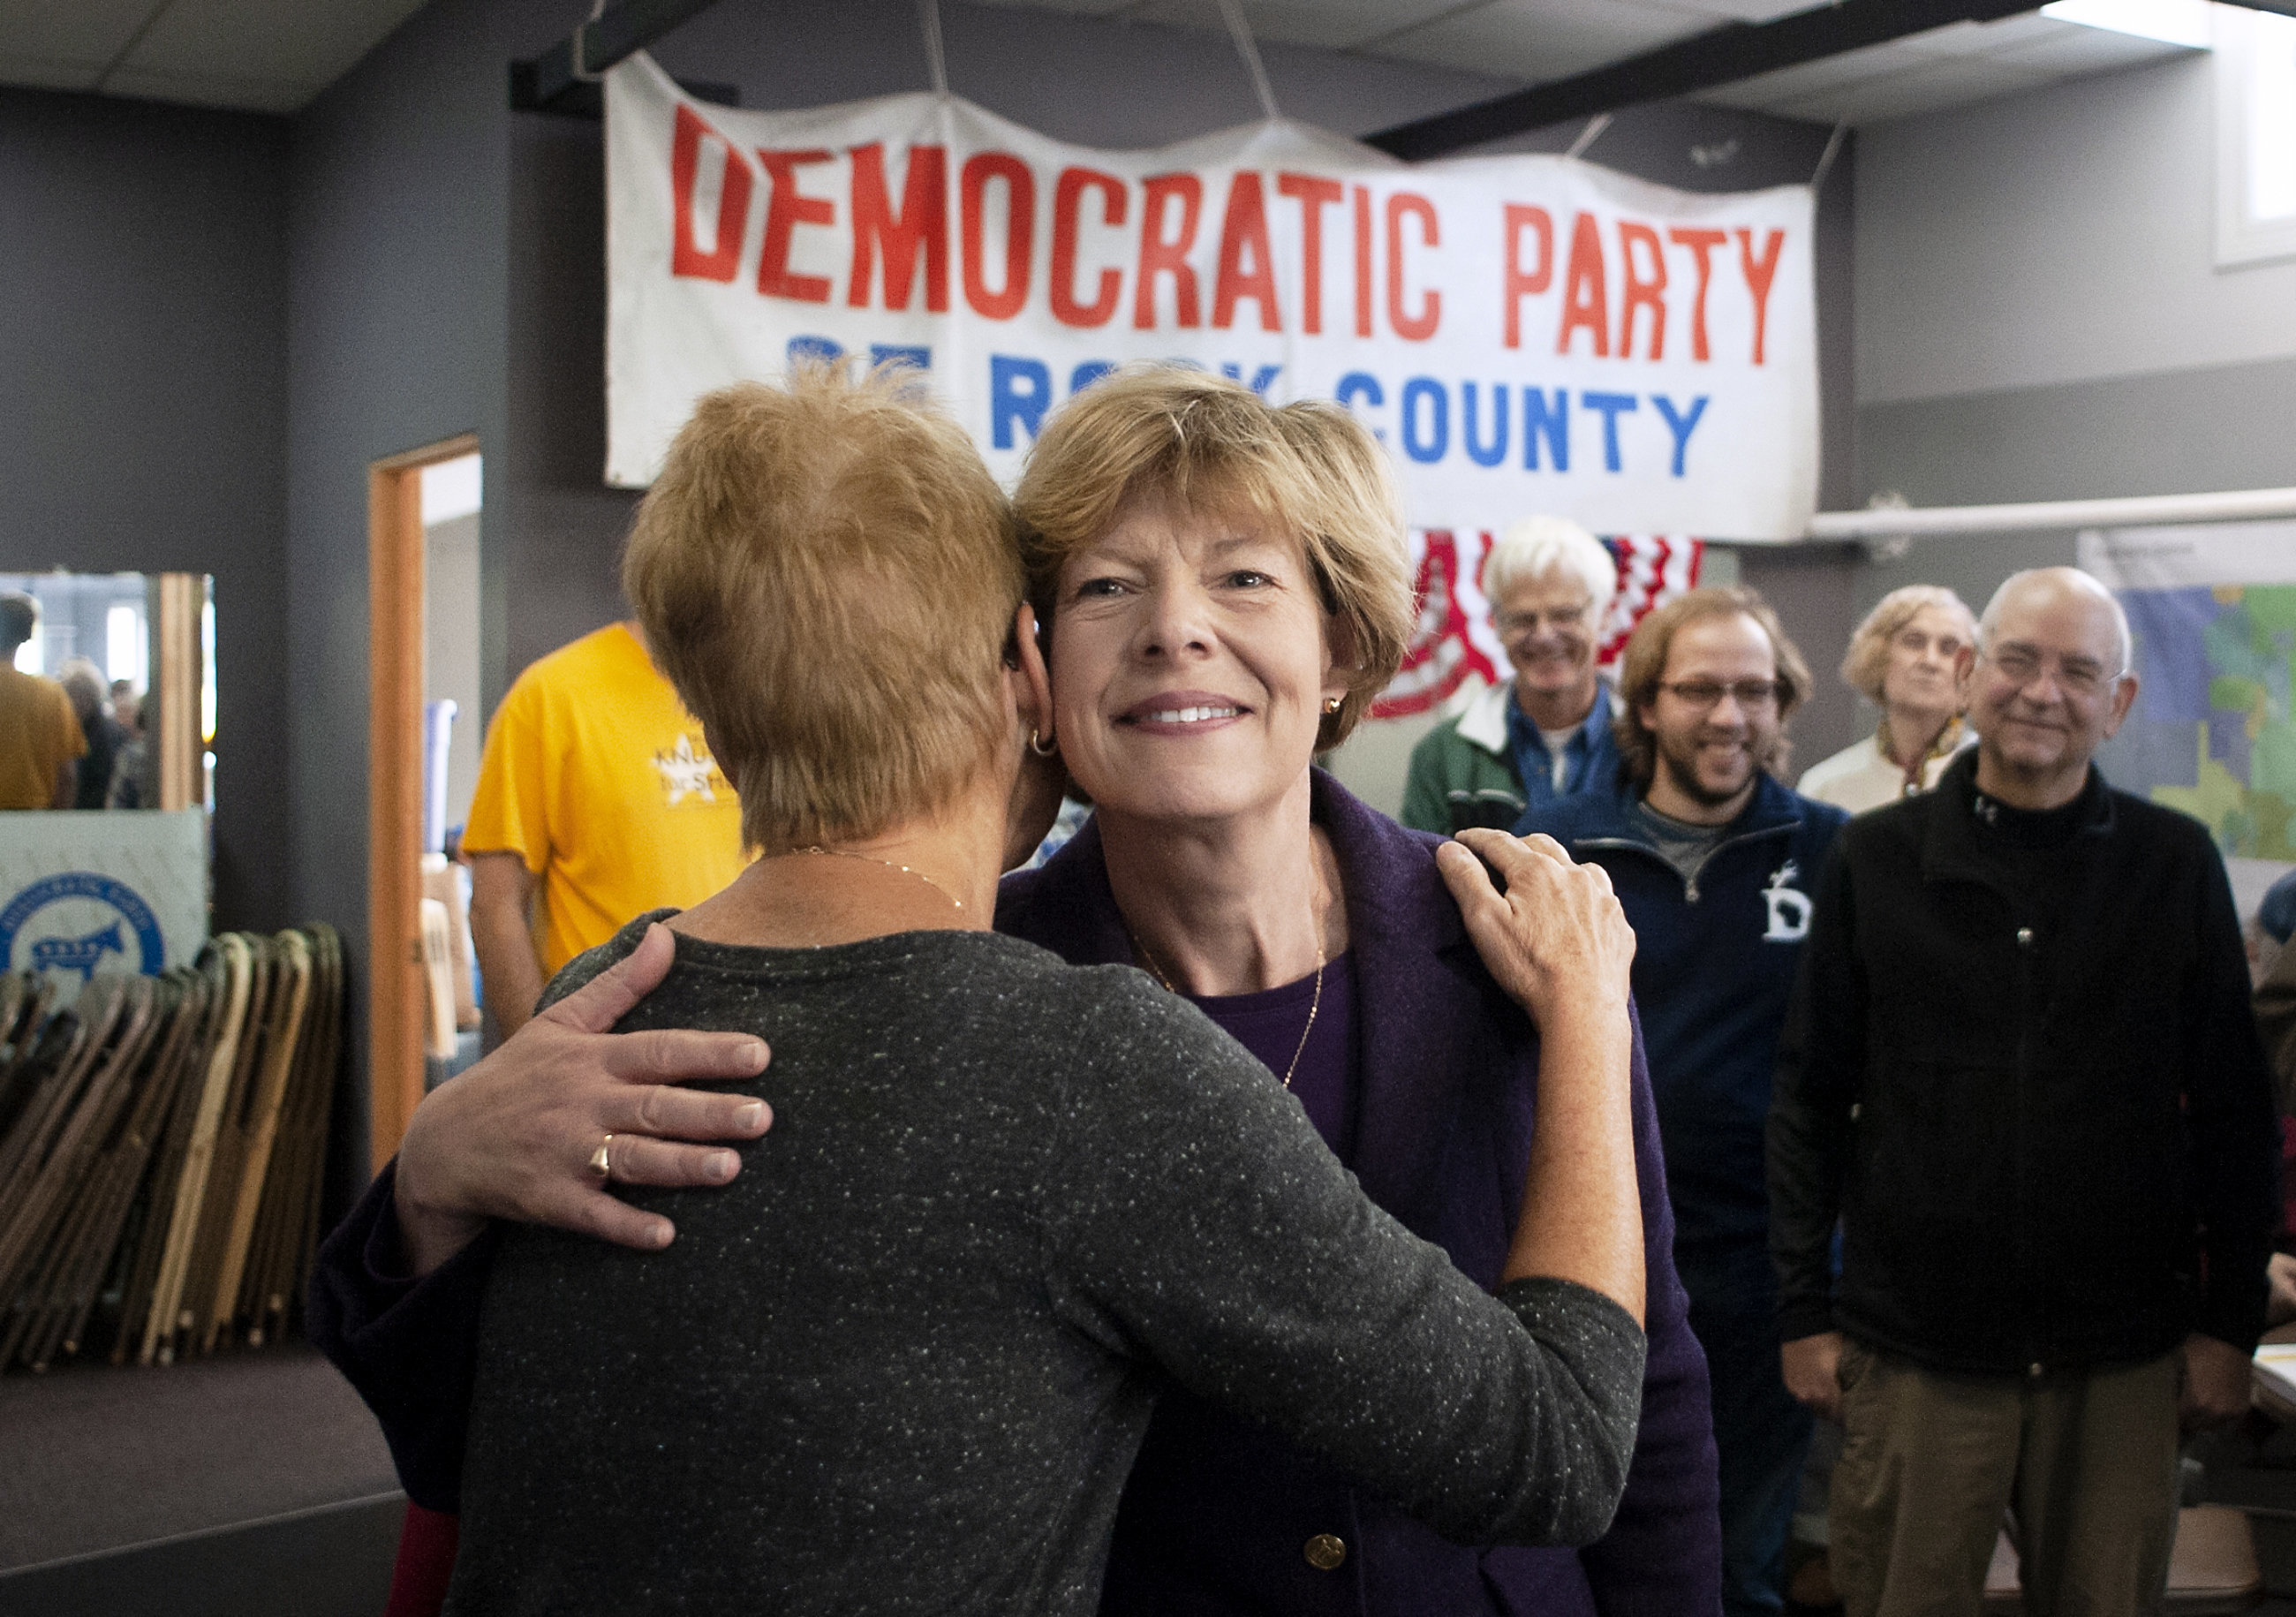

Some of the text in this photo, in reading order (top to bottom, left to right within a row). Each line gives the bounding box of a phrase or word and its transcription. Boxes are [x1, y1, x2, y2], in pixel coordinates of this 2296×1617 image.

[671, 104, 1785, 365] DEMOCRATIC PARTY
[787, 334, 932, 403] F
[654, 746, 716, 767] KNU
[693, 771, 733, 792] SH
